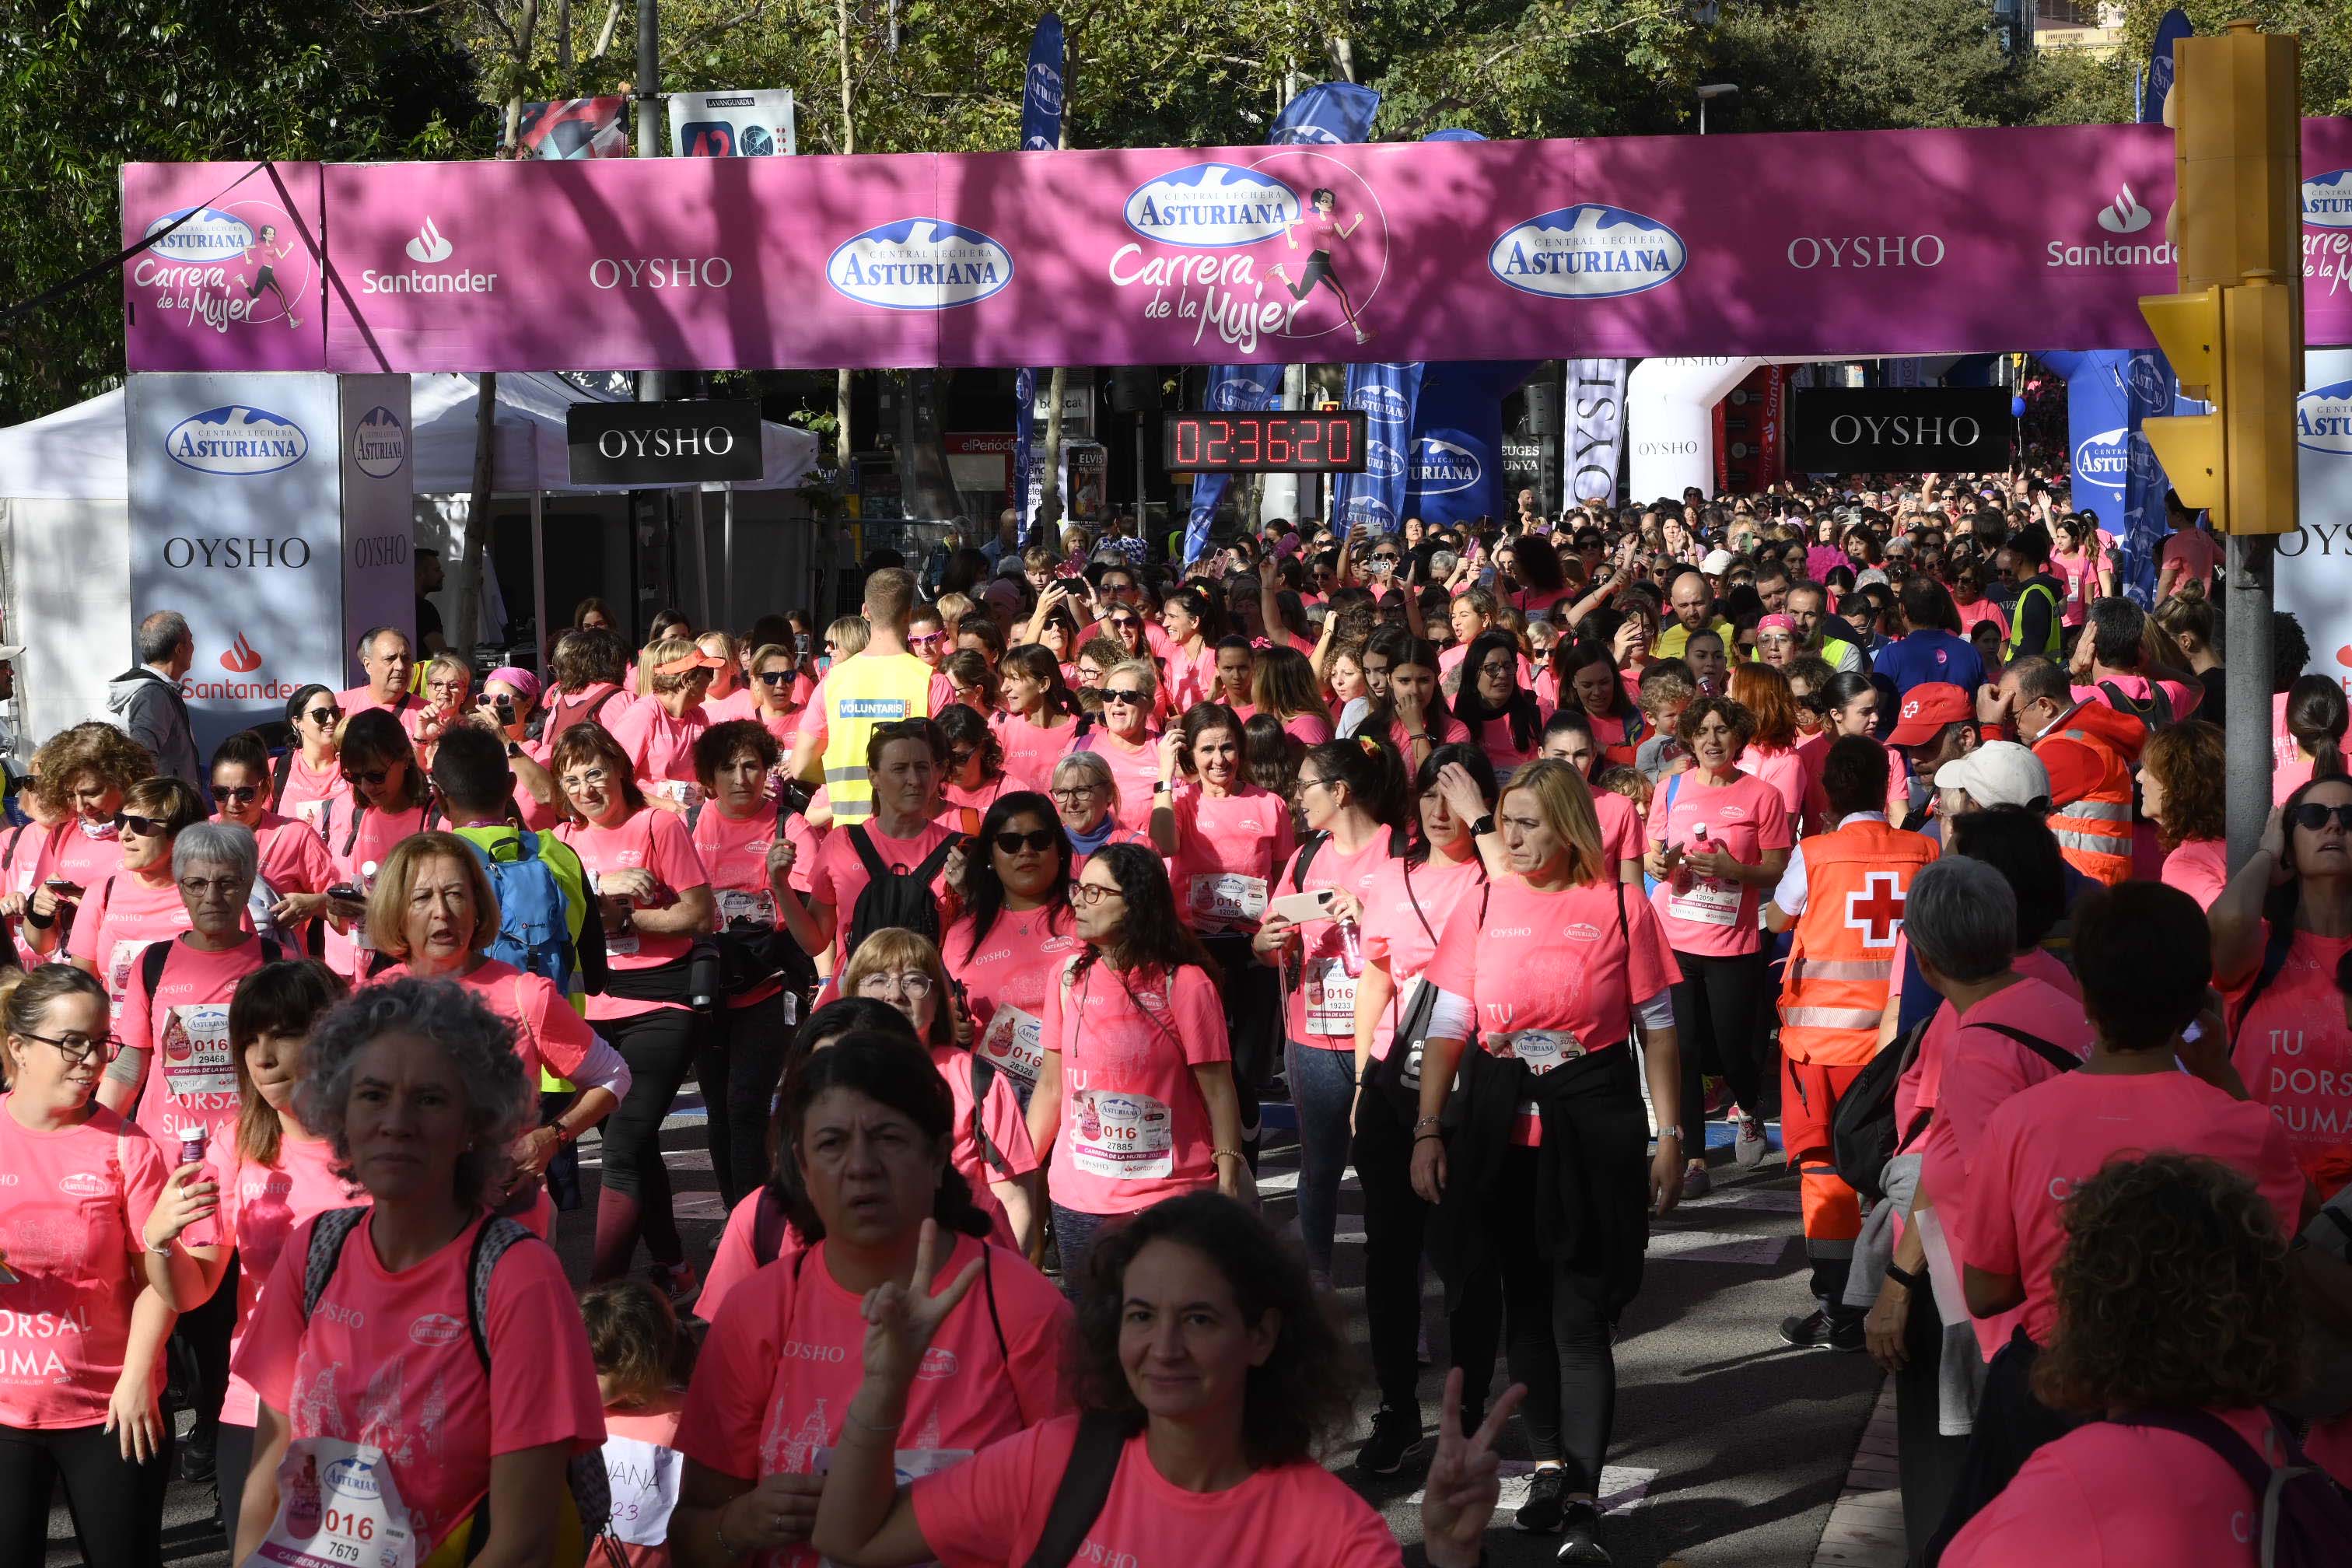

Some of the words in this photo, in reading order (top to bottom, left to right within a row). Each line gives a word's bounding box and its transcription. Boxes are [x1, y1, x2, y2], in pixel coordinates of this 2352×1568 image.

[1137, 194, 1287, 226] ASTURIANA
[1535, 237, 1596, 247] CENTRAL
[1602, 236, 1664, 246] LECHERA
[1787, 235, 1945, 269] OYSHO
[870, 250, 928, 259] CENTRAL
[934, 249, 992, 258] LECHERA
[1108, 243, 1255, 286] Carrera
[1503, 240, 1672, 275] ASTURIANA
[134, 258, 226, 288] Carrera
[590, 257, 732, 289] OYSHO
[841, 253, 999, 286] ASTURIANA
[2319, 256, 2333, 278] la
[362, 269, 497, 292] Santander
[157, 289, 173, 309] de
[178, 287, 189, 309] la
[187, 286, 260, 333] Mujer
[1145, 289, 1171, 318] de
[1178, 286, 1196, 318] la
[1193, 282, 1309, 354] Mujer
[1830, 415, 1980, 446] OYSHO
[177, 432, 299, 457] ASTURIANA
[358, 433, 402, 461] ASTURIANA
[599, 426, 733, 458] OYSHO
[1178, 420, 1352, 463] 02:36:20
[1639, 440, 1697, 456] OYSHO
[1079, 453, 1103, 464] ELVIS
[2081, 450, 2128, 472] ASTU
[1410, 466, 1473, 480] URIANA
[163, 537, 310, 569] OYSHO
[355, 534, 406, 569] OYSHO
[182, 678, 302, 700] Santander
[841, 703, 903, 714] VOLUNTARIS
[1694, 882, 1718, 894] 016
[1217, 897, 1242, 908] 016
[107, 914, 142, 923] OYSHO
[1491, 927, 1531, 938] OYSHO
[1566, 929, 1599, 939] ASTURIANA
[1043, 940, 1073, 952] ASTURIANA
[975, 949, 1011, 966] OYSHO
[1327, 988, 1353, 999] 016
[1487, 1003, 1512, 1024] TU
[194, 1038, 229, 1052] 016
[1517, 1043, 1556, 1052] ASTURIANA
[2269, 1030, 2303, 1055] TU
[198, 1055, 225, 1064] 29468
[1013, 1046, 1043, 1068] 016
[1010, 1061, 1034, 1076] 28328
[1066, 1068, 1087, 1090] TU
[1532, 1064, 1552, 1076] 16
[1103, 1105, 1138, 1116] ASTURIANA
[1104, 1125, 1136, 1139] 016
[1084, 1148, 1108, 1158] CARRERA
[1107, 1142, 1132, 1151] 27885
[327, 1468, 379, 1492] ASTURIAN
[325, 1508, 374, 1541] 016
[329, 1541, 359, 1562] 7679
